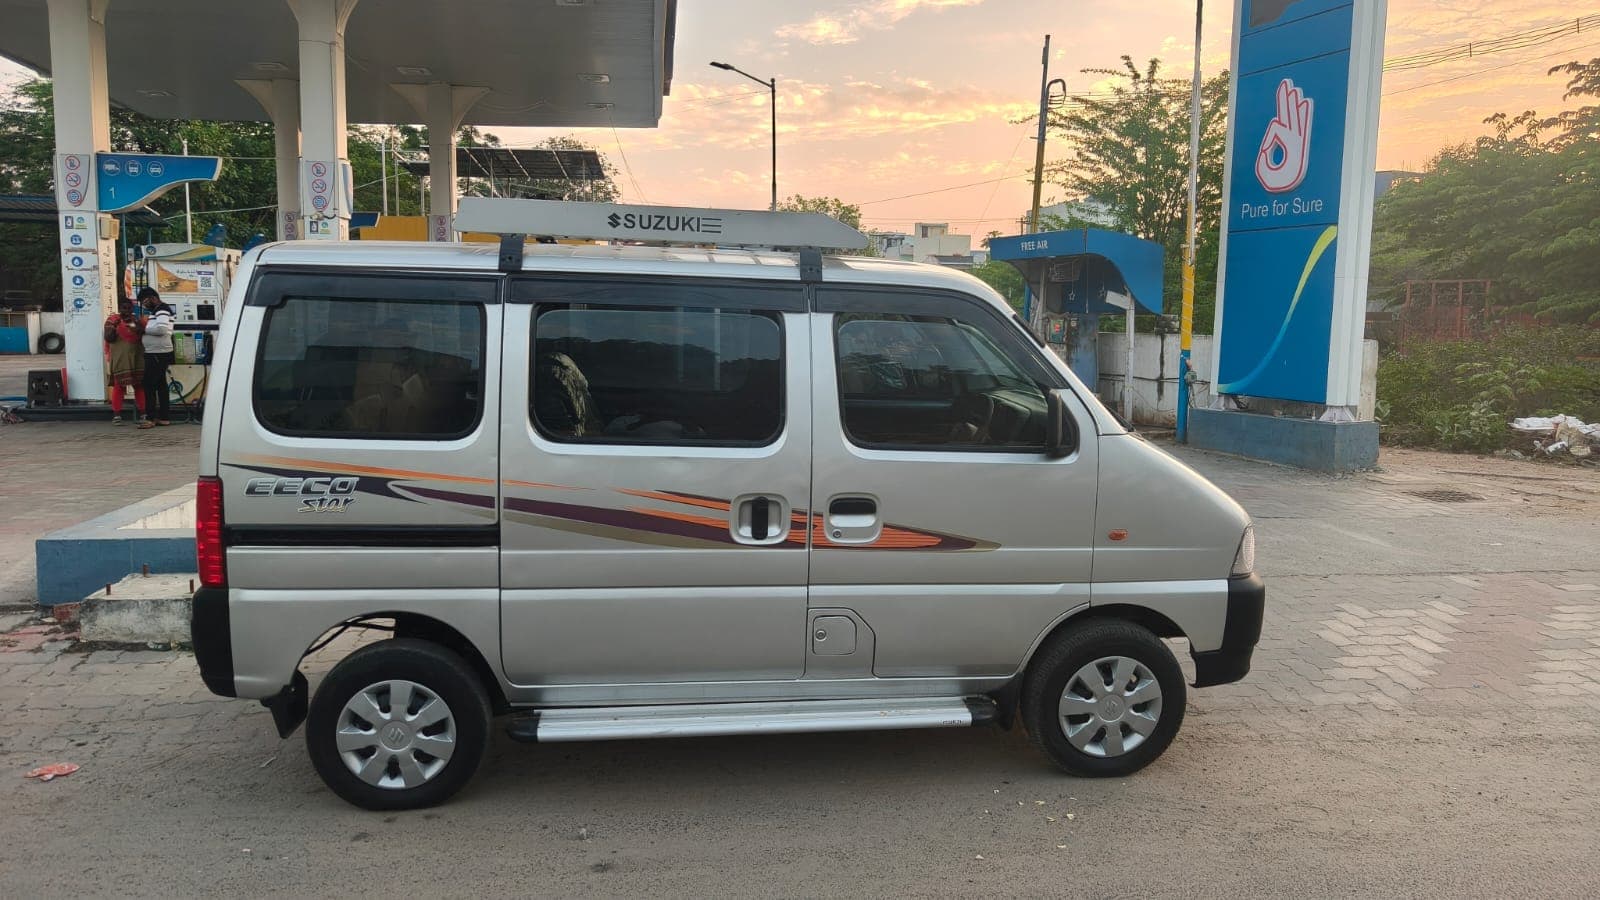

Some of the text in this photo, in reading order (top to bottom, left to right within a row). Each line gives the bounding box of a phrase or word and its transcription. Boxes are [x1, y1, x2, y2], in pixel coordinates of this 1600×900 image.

[108, 186, 115, 200] 1
[1241, 197, 1323, 219] Pure for Sure
[623, 213, 700, 233] SUZUKI
[1021, 239, 1048, 251] FREE AIR
[244, 477, 360, 497] EECO
